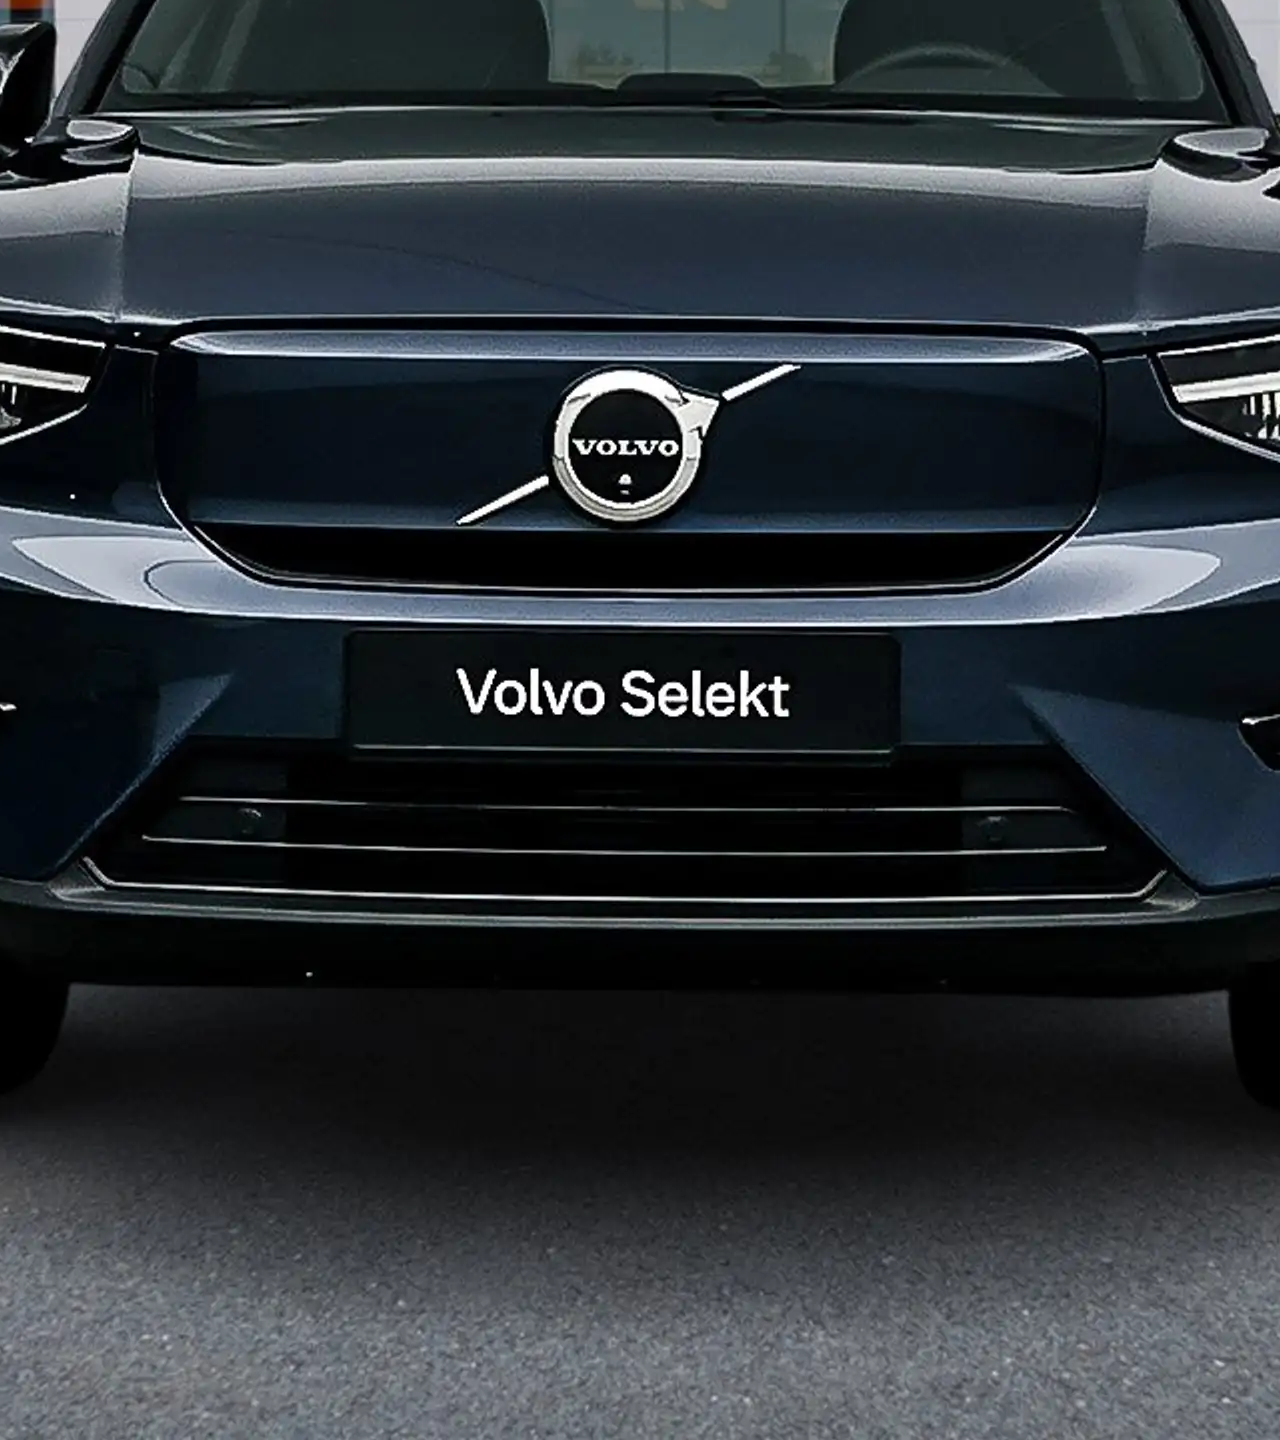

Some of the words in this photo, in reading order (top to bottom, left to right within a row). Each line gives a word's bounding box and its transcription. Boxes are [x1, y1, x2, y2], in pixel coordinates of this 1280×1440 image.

[571, 437, 680, 457] VOLVO
[455, 668, 606, 717] Volvo
[620, 669, 791, 719] Selekt
